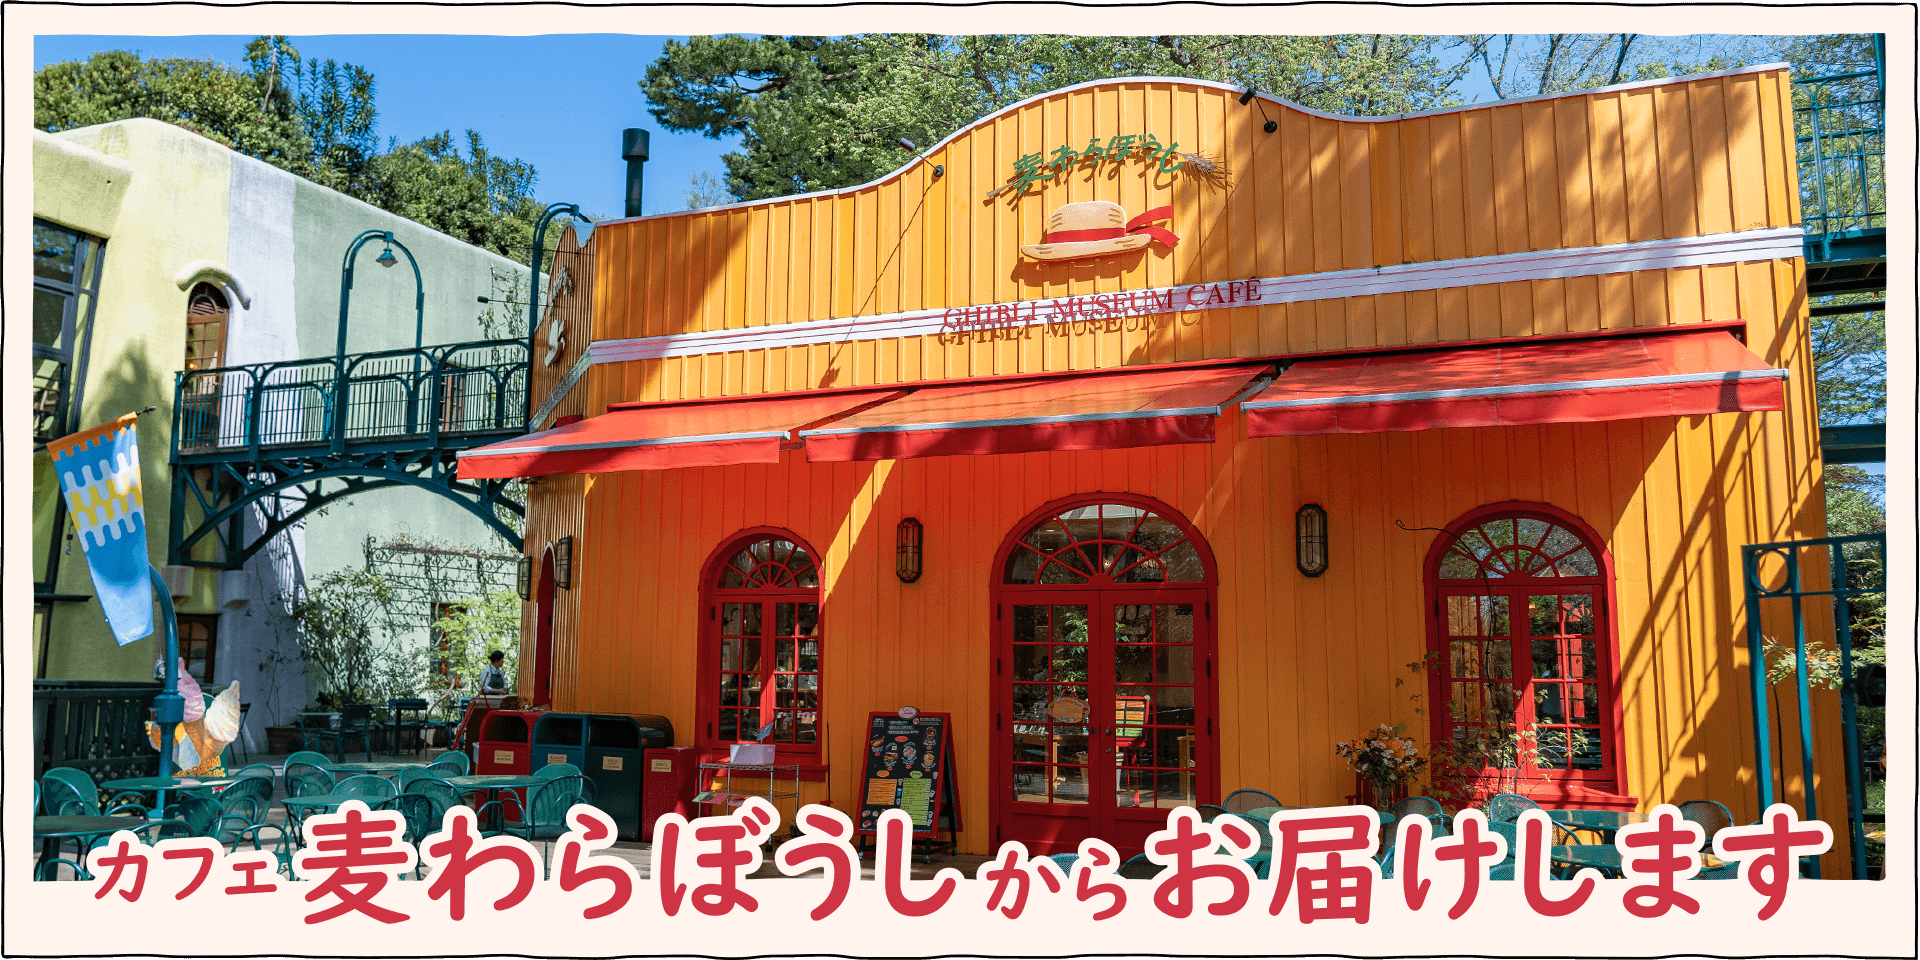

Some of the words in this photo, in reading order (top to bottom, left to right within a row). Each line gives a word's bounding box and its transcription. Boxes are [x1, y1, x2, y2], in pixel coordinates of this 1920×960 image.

[1013, 133, 1184, 195] 麦わらぼうし
[943, 301, 1038, 328] GHIBLI
[1053, 288, 1175, 319] MUSEUM
[1187, 275, 1262, 306] CAFÉ
